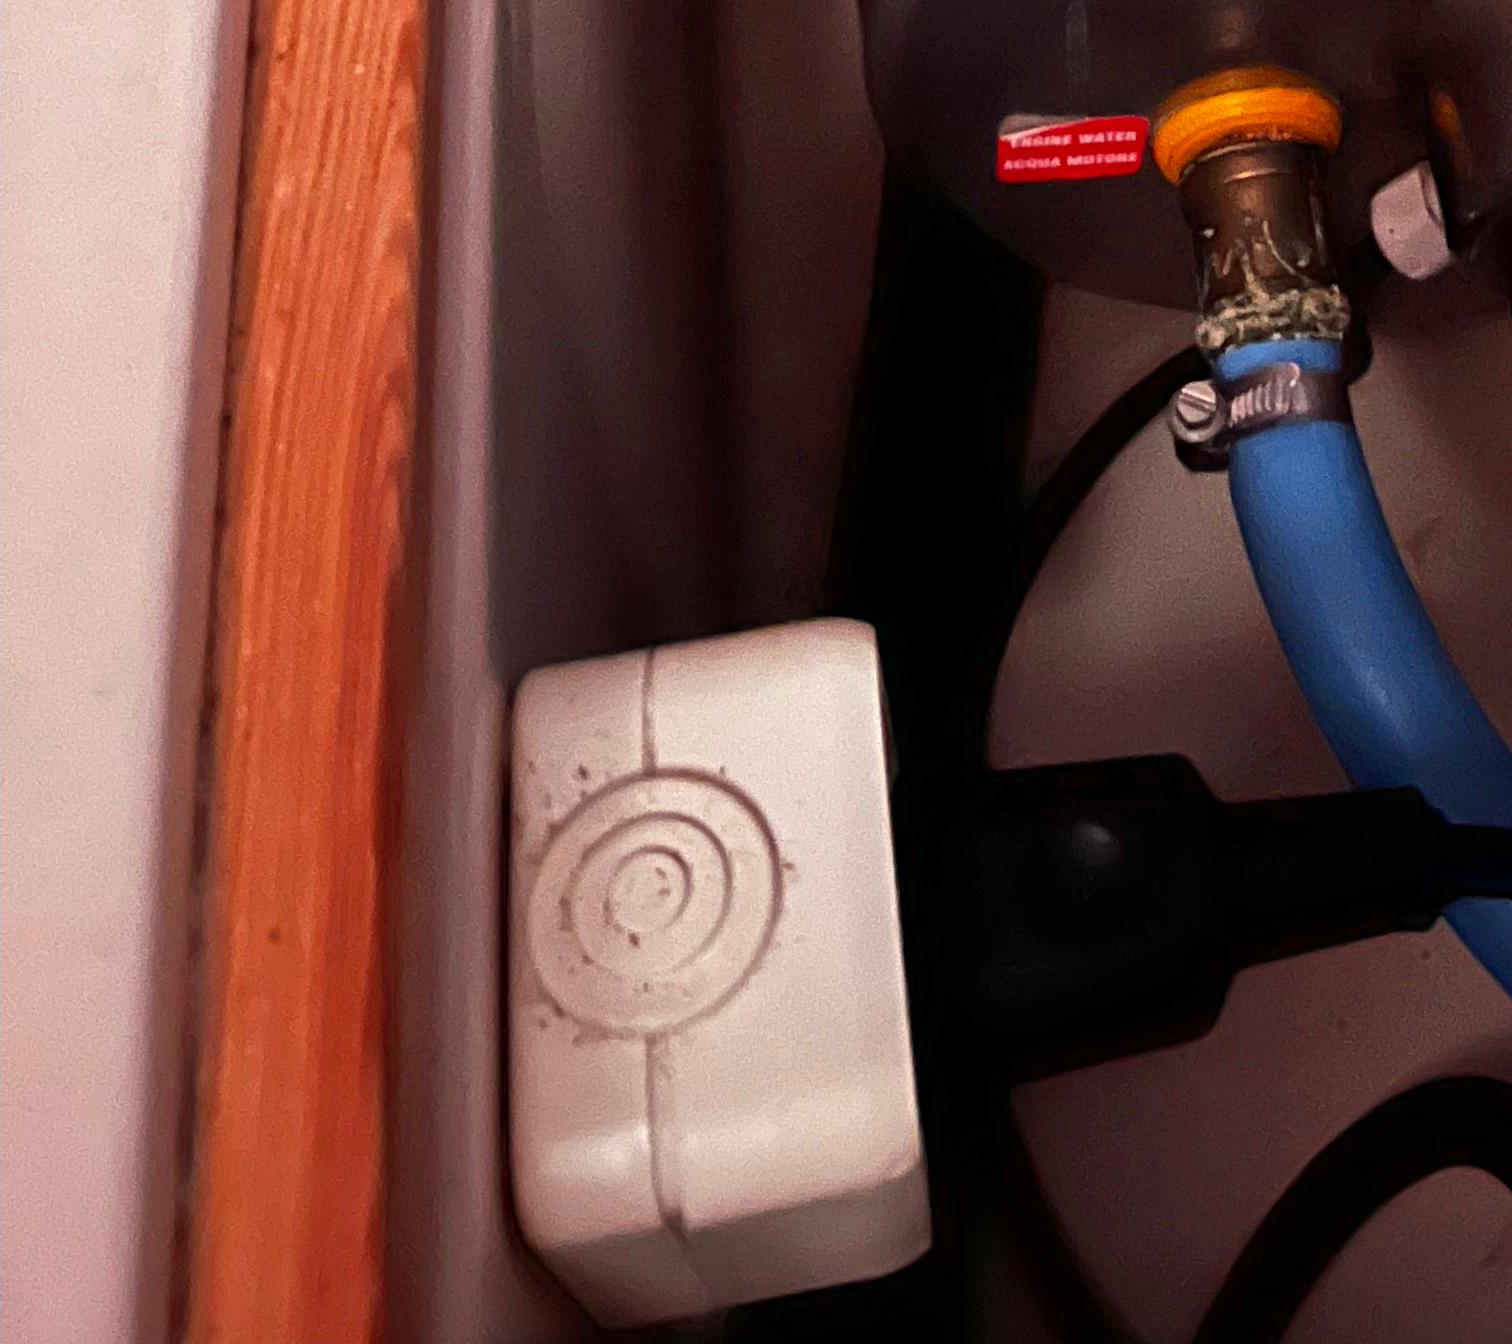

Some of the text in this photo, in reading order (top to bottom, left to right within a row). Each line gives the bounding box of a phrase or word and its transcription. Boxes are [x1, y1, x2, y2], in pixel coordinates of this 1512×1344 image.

[1078, 130, 1138, 145] WATER
[1003, 151, 1138, 171] ACQUA MOTORE
